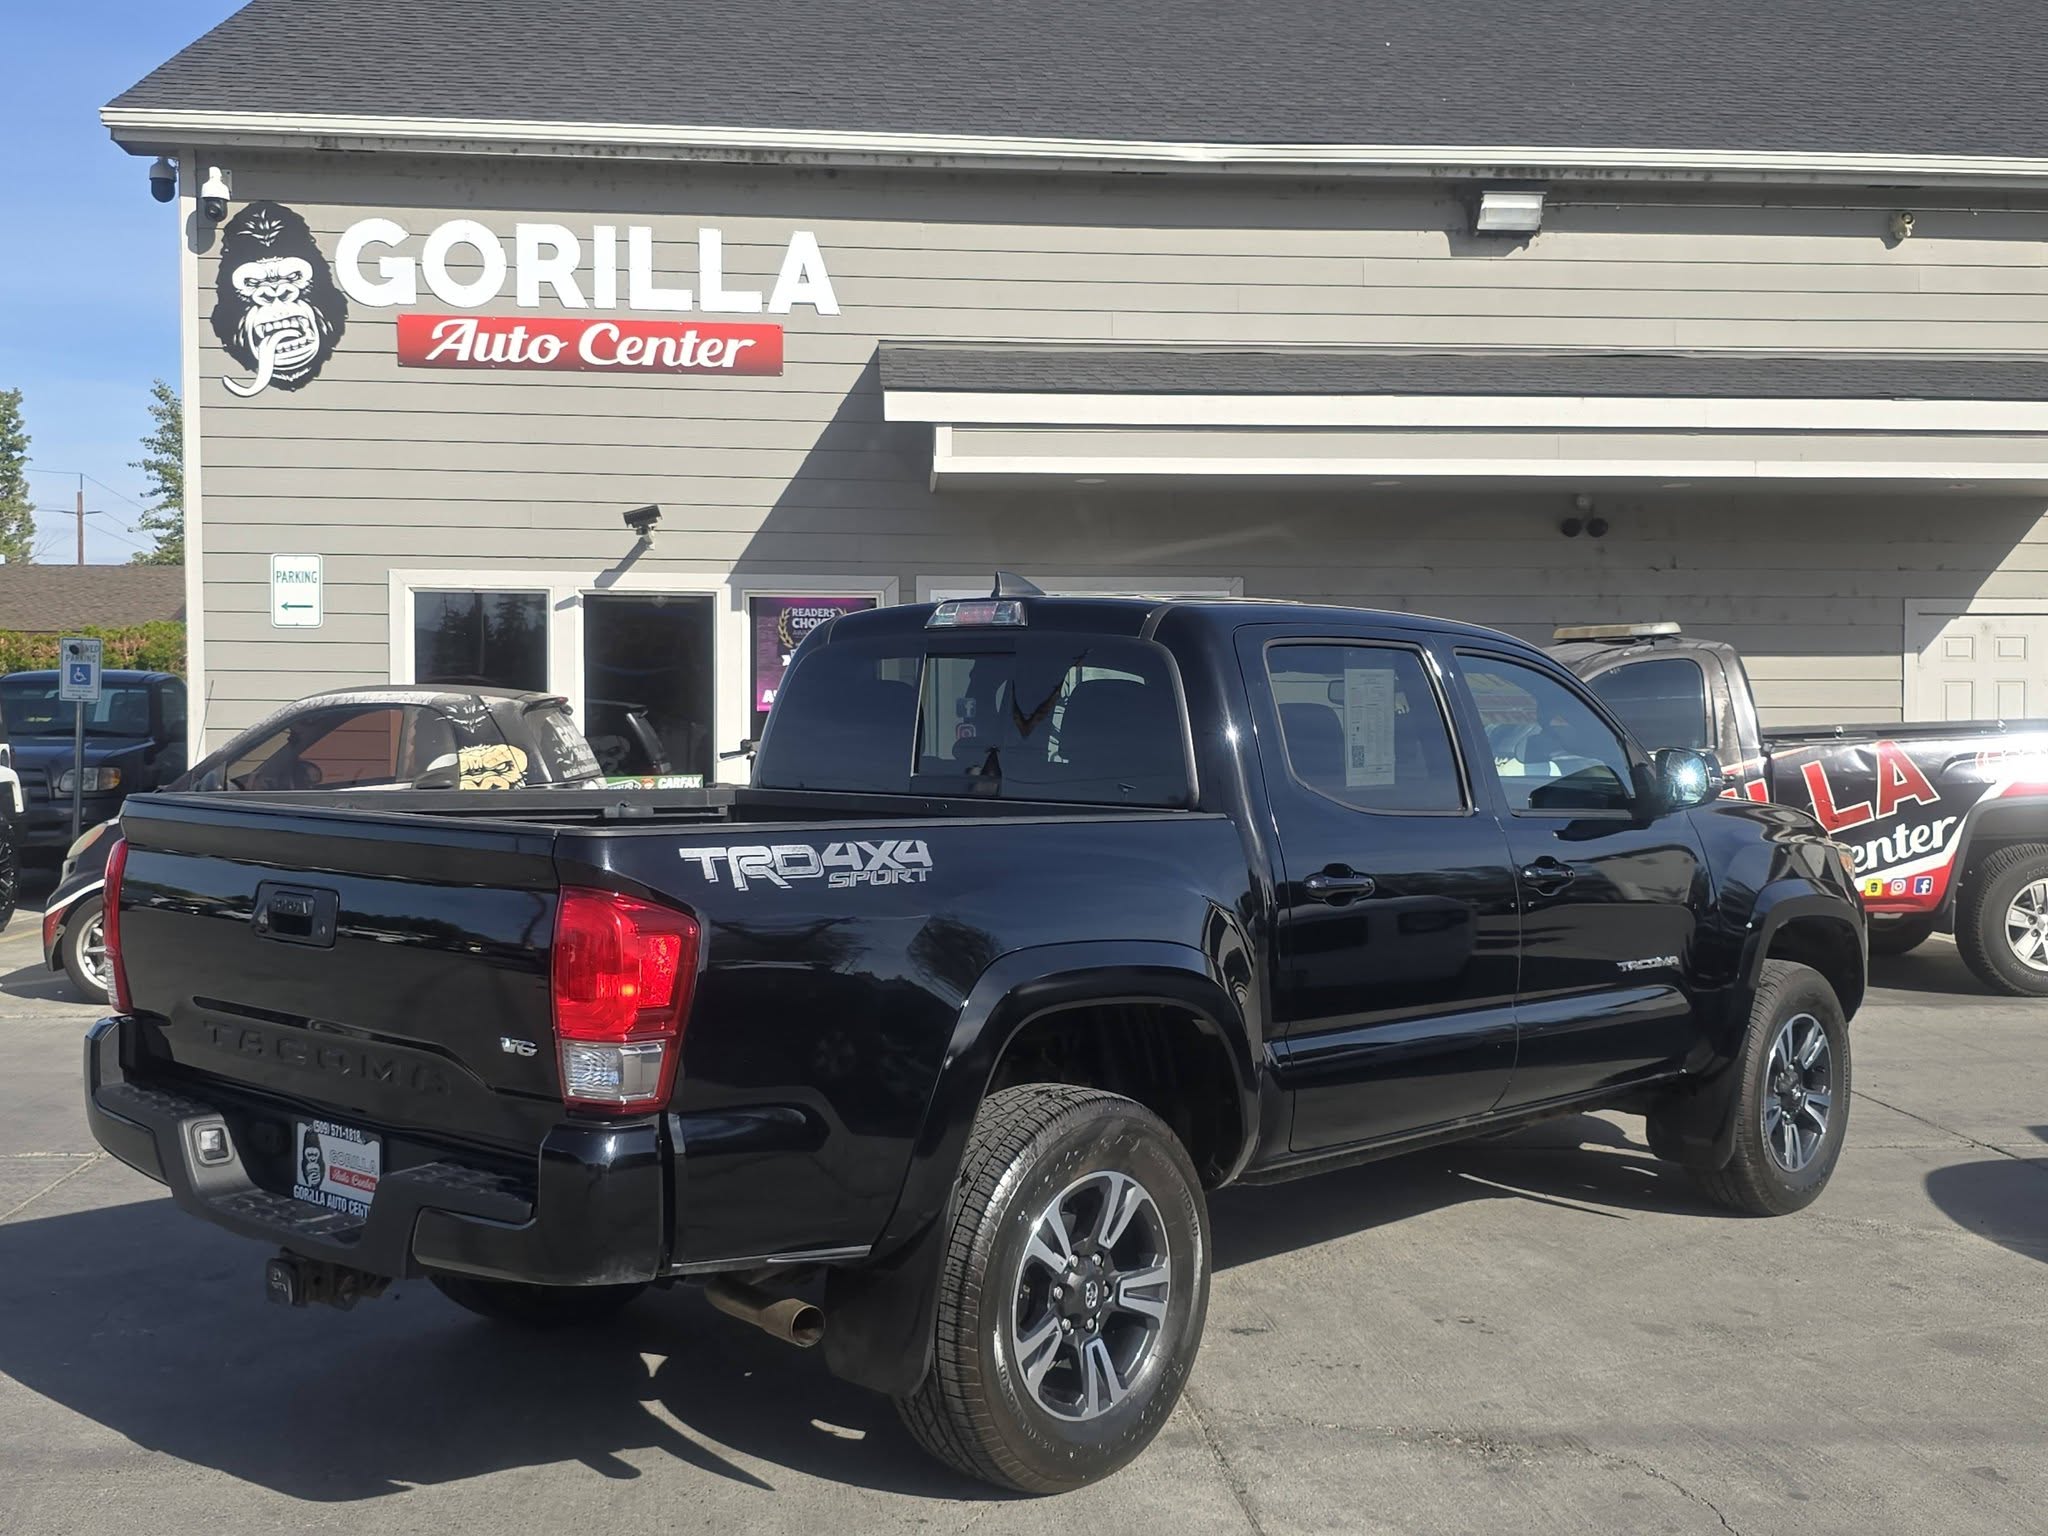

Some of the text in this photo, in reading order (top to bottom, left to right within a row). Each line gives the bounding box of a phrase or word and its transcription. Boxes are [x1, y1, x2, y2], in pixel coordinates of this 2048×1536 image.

[335, 218, 840, 316] GORILLA
[425, 318, 757, 368] Auto Center
[275, 570, 318, 584] PARKING
[792, 607, 835, 617] READERS
[657, 776, 701, 789] CARFAX
[1853, 816, 1957, 872] enter
[679, 840, 933, 891] TRD 4X4
[828, 867, 933, 888] SPORT
[1616, 956, 1680, 972] TACOMA
[203, 1021, 449, 1095] TACOMA
[500, 1036, 538, 1057] V6
[293, 1184, 371, 1219] GORILLA AUTO CENT
